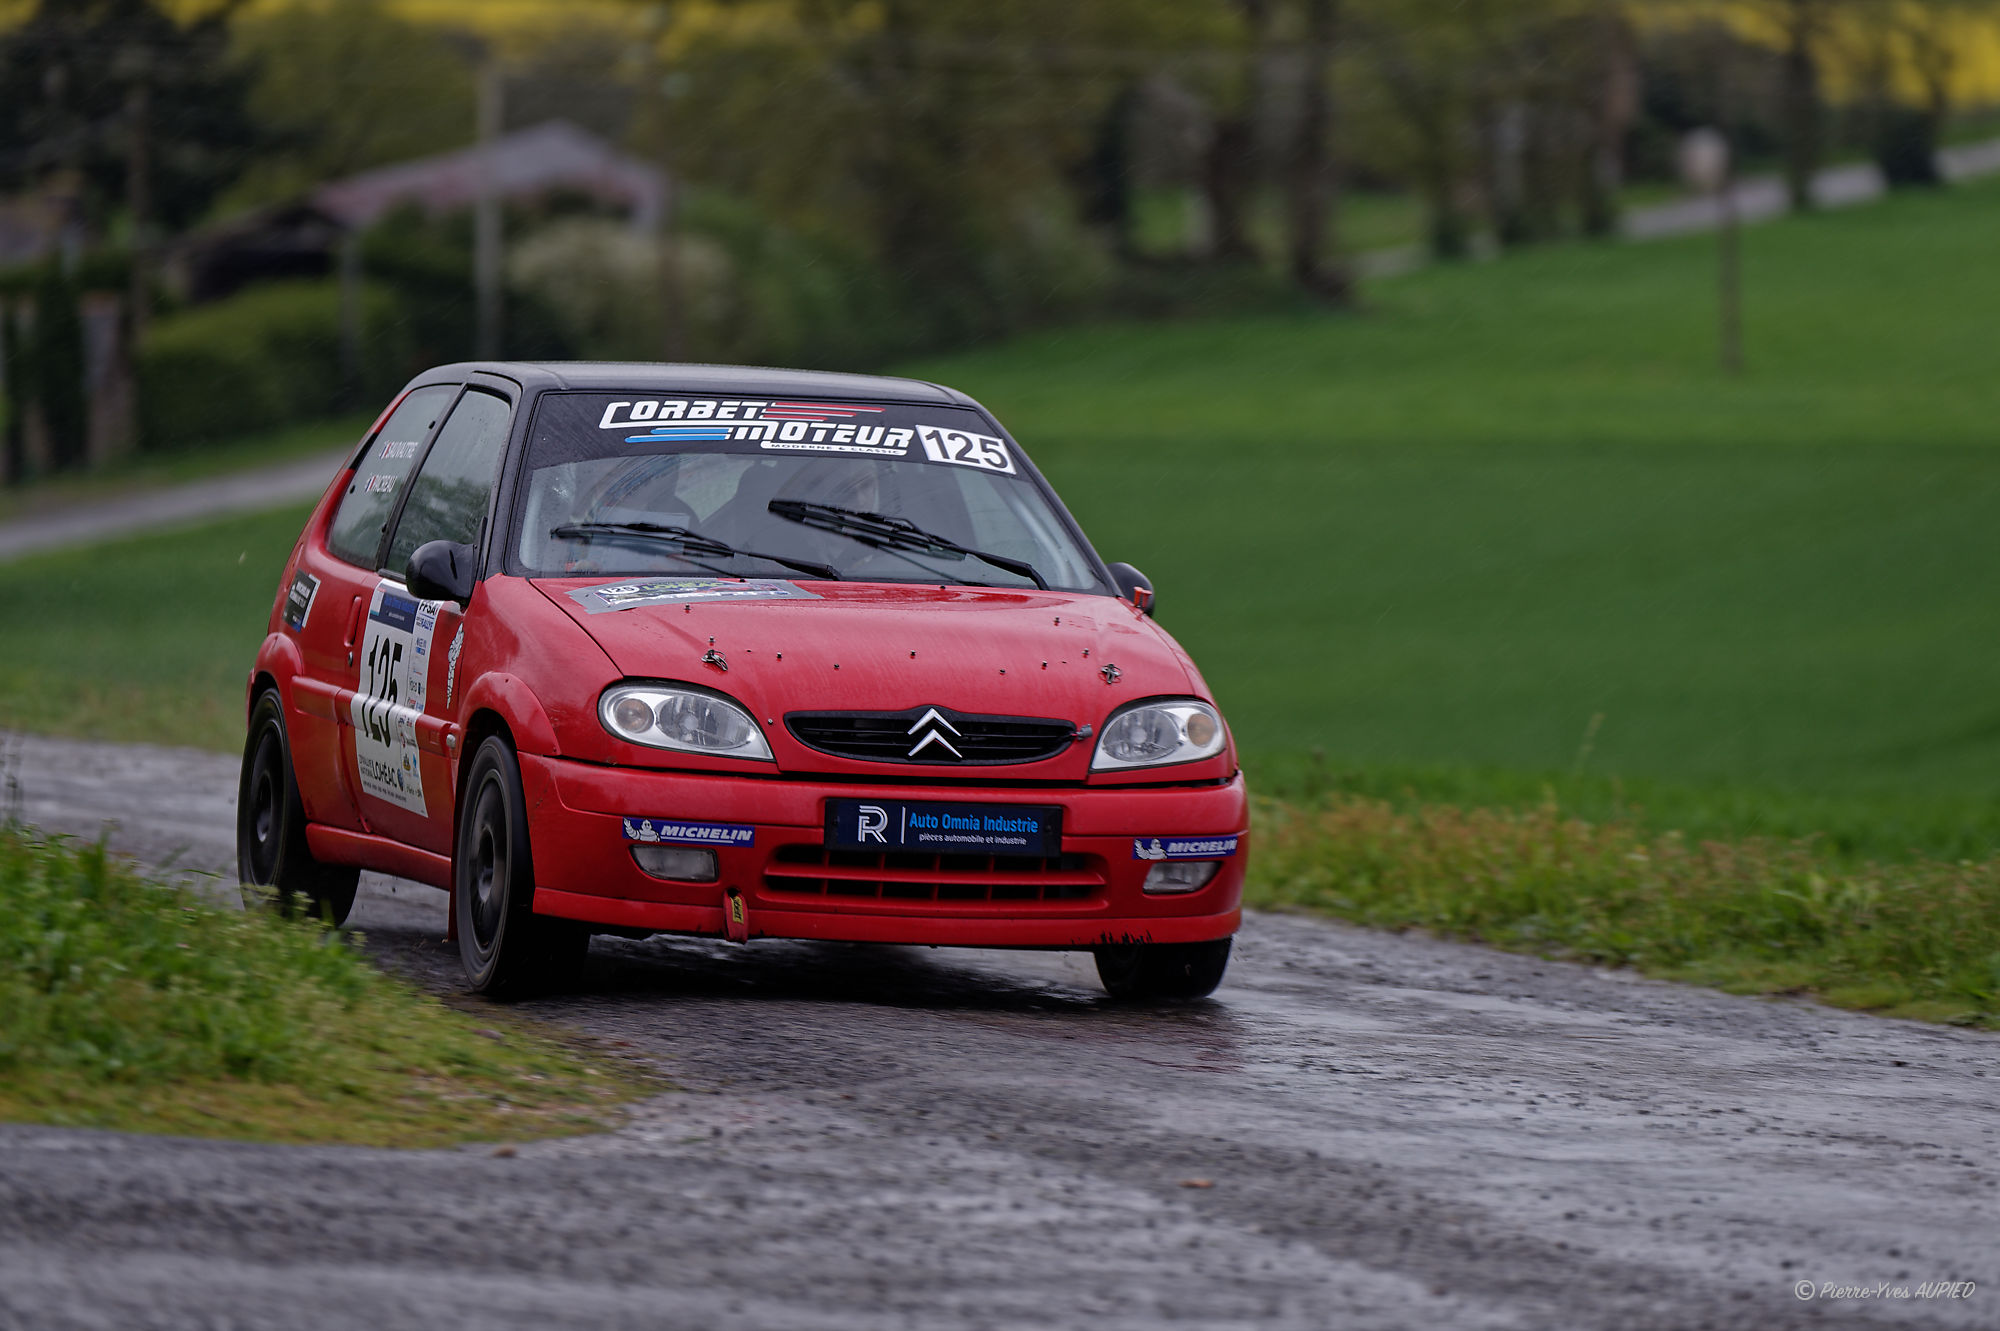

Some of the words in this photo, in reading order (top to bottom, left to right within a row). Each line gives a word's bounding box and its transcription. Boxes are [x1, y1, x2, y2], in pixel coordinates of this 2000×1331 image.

[599, 400, 767, 429] CORBET
[734, 420, 915, 448] MOTEUR
[770, 443, 833, 451] MODERNE
[925, 429, 1009, 469] 125
[606, 585, 637, 594] 125
[362, 634, 403, 748] 125
[908, 812, 939, 829] Auto
[942, 813, 981, 831] Omnia
[984, 815, 1039, 833] Industrie
[660, 825, 753, 841] MICHELIN
[944, 834, 985, 844] automobile
[995, 836, 1027, 846] industrie
[1167, 839, 1238, 852] MICHELIN
